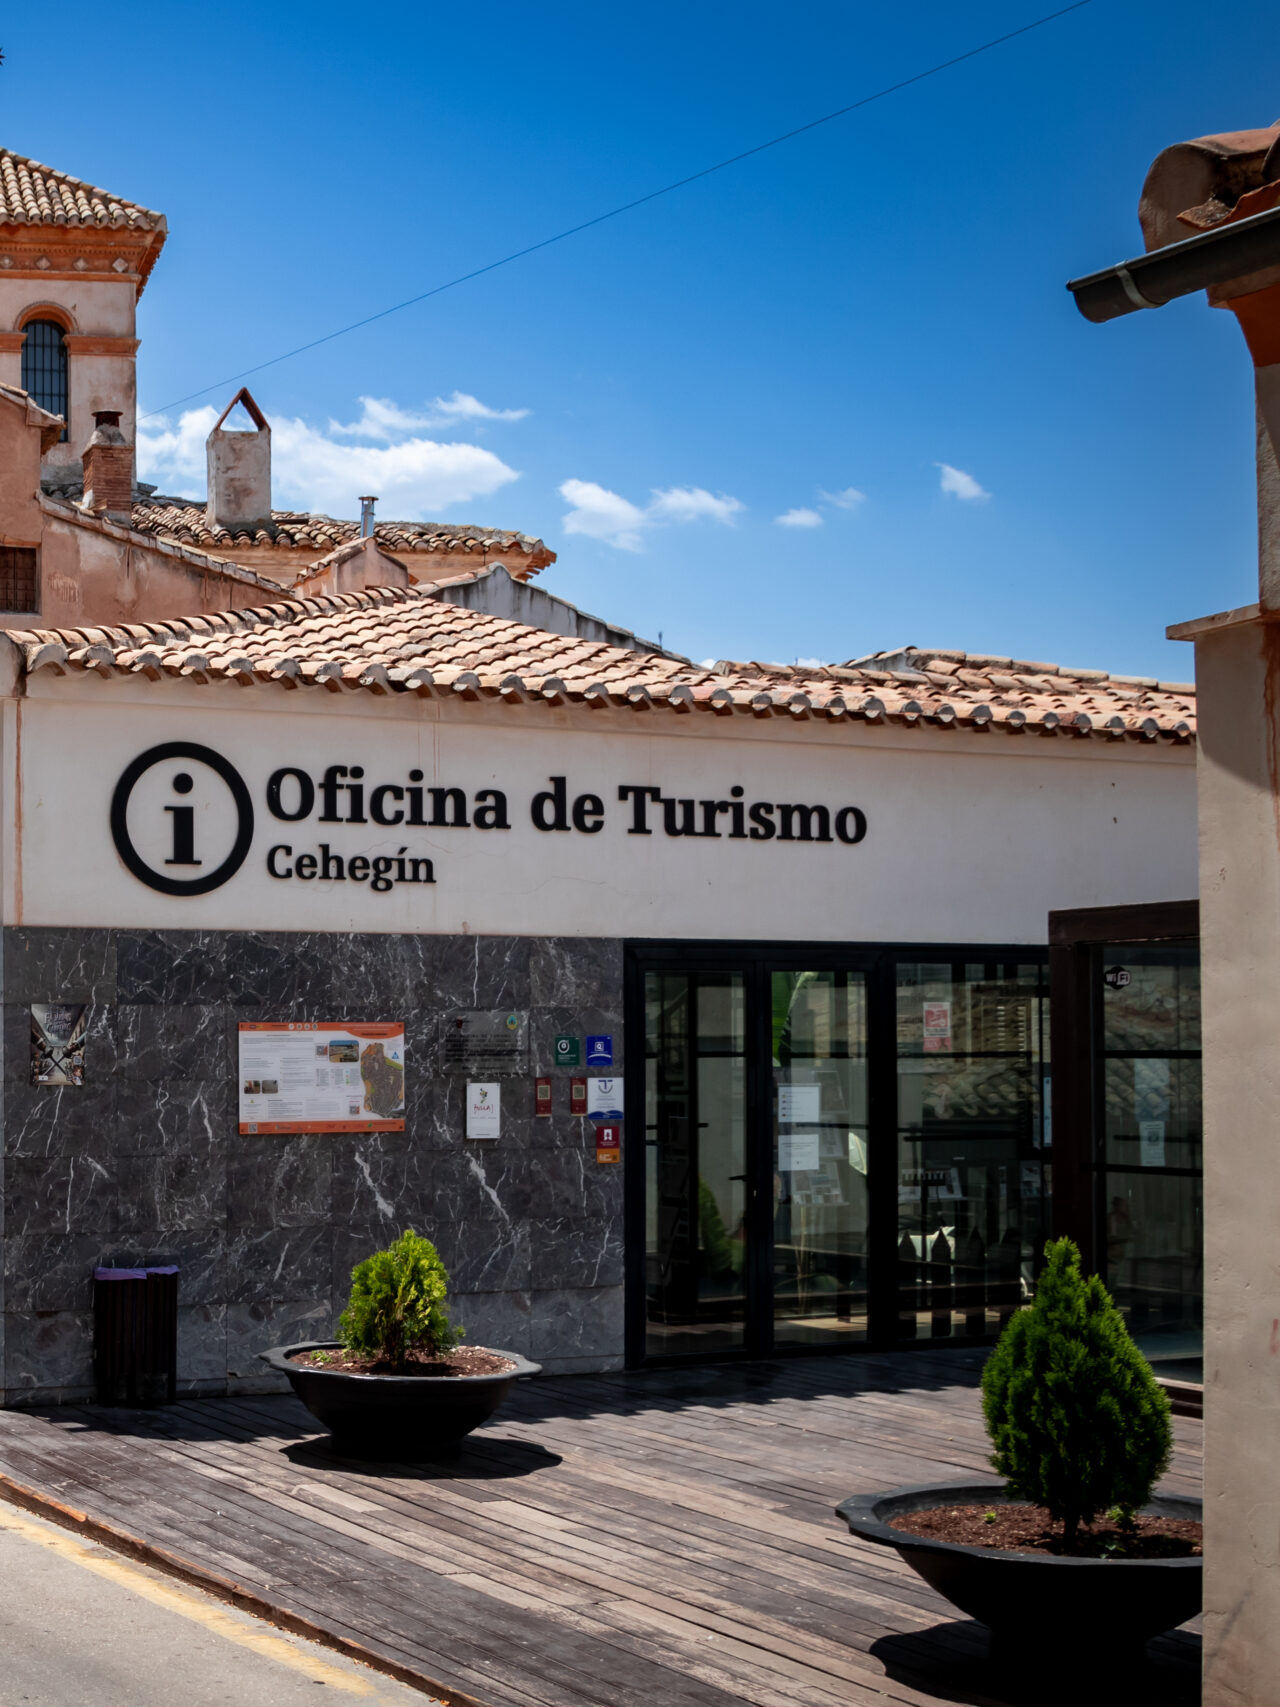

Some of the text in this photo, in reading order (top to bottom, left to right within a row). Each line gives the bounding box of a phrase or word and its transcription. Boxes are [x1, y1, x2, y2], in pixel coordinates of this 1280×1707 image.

[266, 766, 868, 845] Oficina de Turismo
[266, 844, 437, 893] Cehegín
